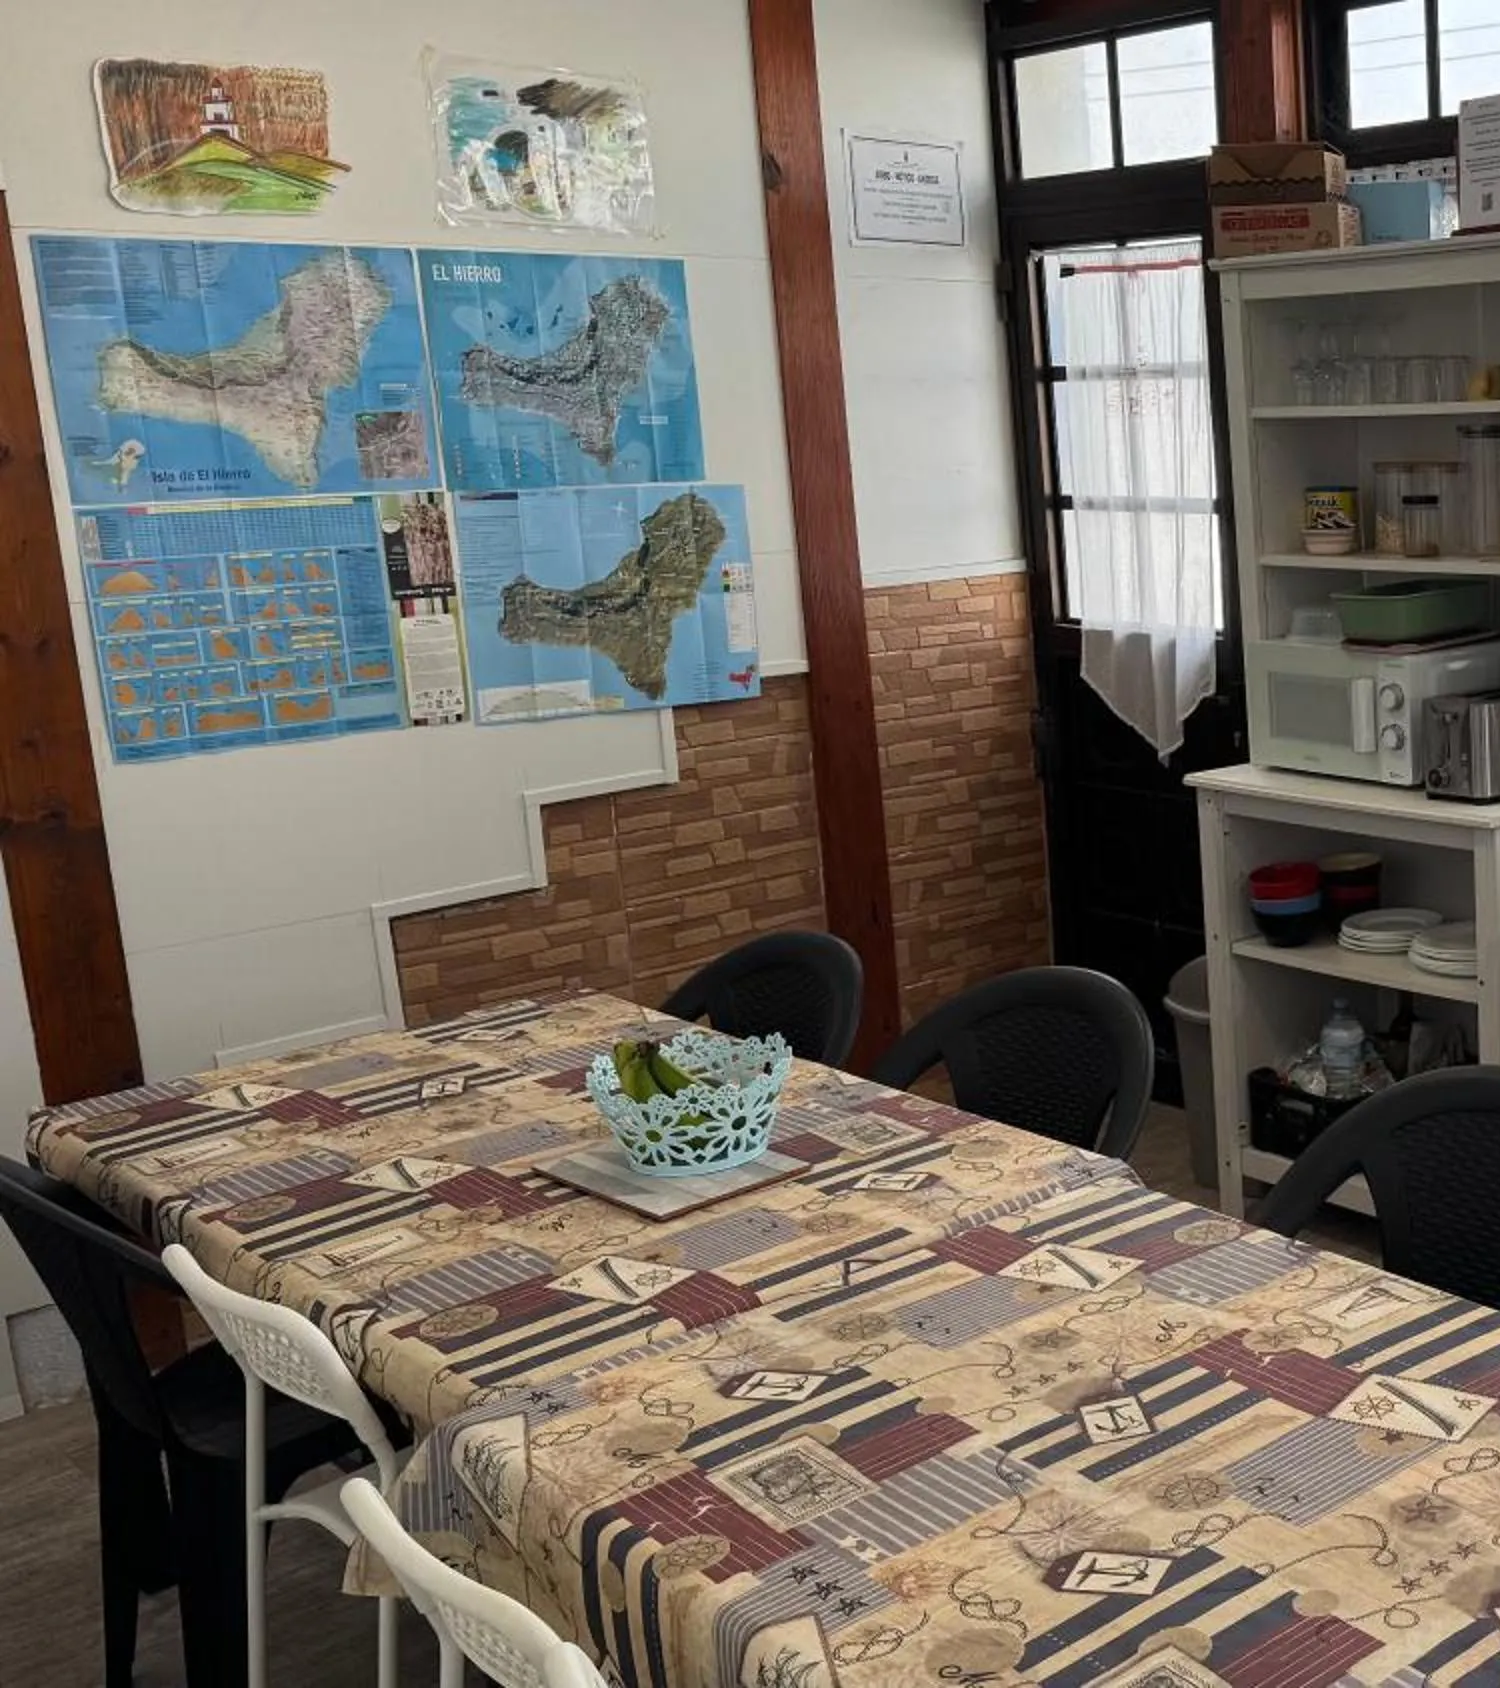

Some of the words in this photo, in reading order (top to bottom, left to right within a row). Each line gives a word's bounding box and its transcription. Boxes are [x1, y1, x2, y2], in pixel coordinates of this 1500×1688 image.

[432, 263, 450, 281] EL
[453, 264, 501, 283] HIERRO
[152, 471, 176, 483] Isla
[179, 470, 195, 482] de
[198, 468, 209, 480] El
[213, 467, 251, 480] Hierro
